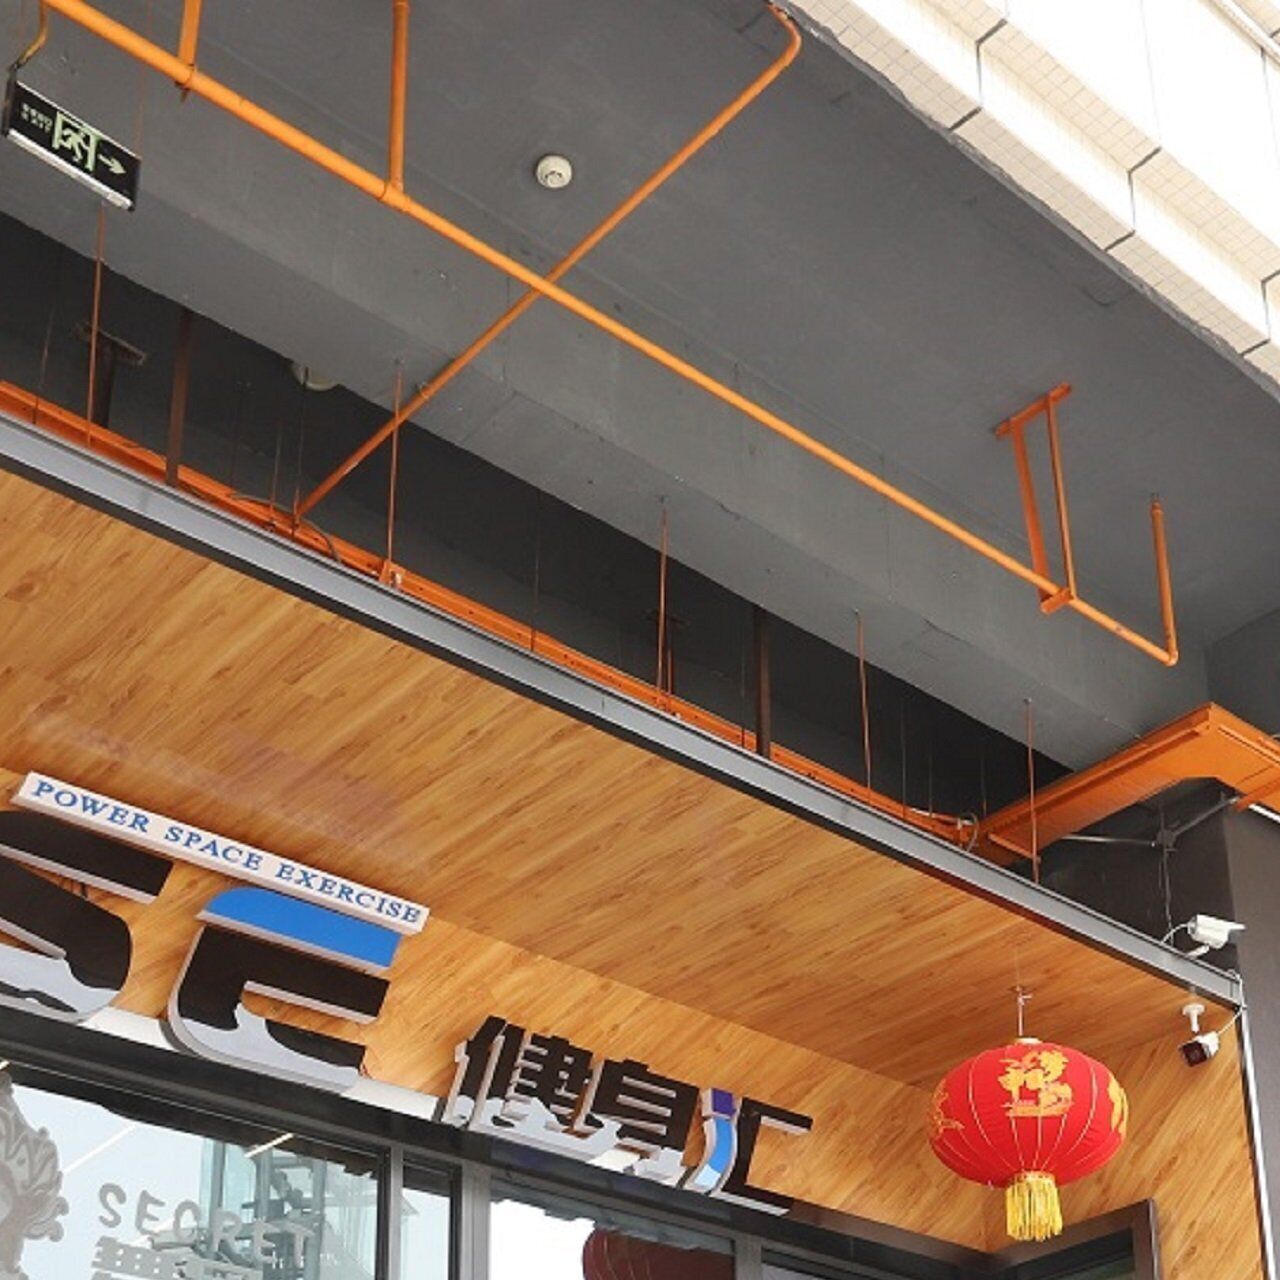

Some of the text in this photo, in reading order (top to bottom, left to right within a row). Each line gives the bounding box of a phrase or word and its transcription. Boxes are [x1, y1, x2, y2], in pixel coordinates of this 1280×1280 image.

[33, 780, 422, 925] POWER SPACE EXERCISE
[97, 1182, 317, 1269] SECRET
